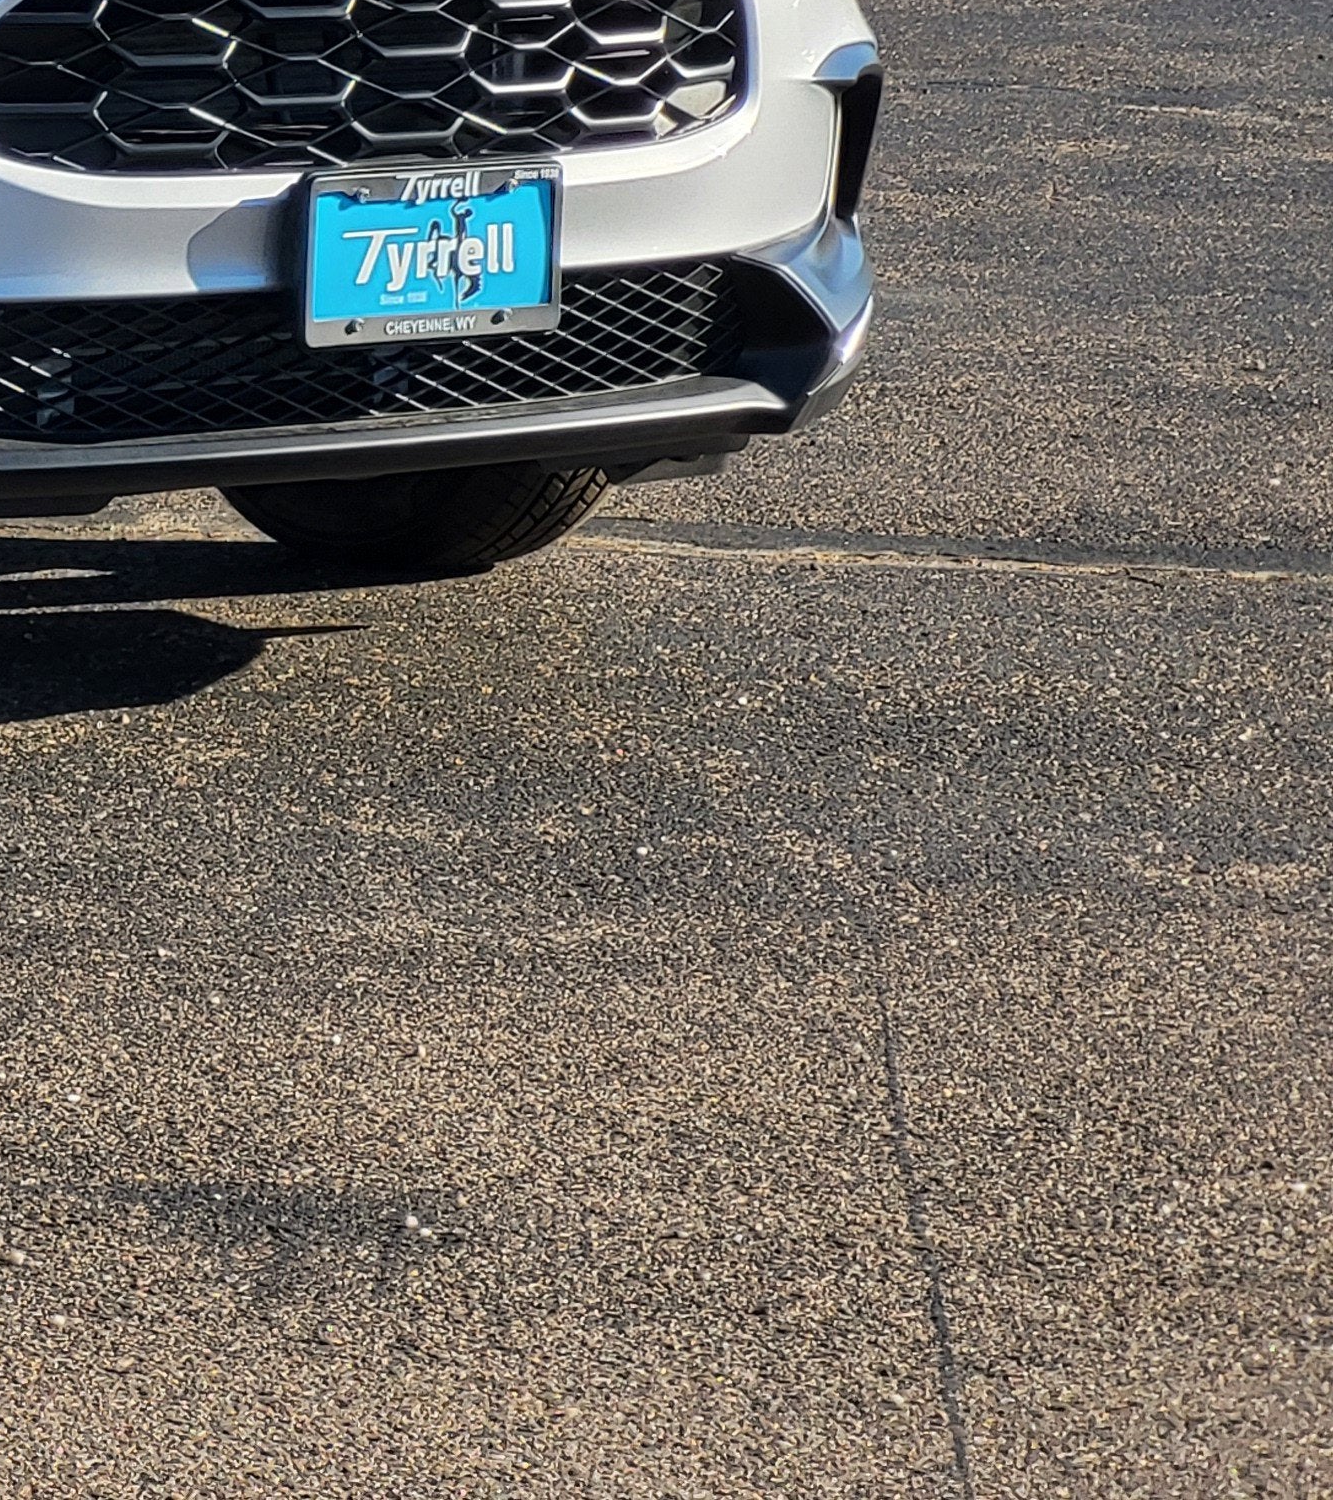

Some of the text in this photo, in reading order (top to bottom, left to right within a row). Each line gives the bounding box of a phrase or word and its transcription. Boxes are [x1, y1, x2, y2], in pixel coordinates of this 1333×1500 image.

[396, 170, 482, 204] Tyrrell
[342, 223, 514, 292] Tyrrell
[455, 315, 476, 330] WY
